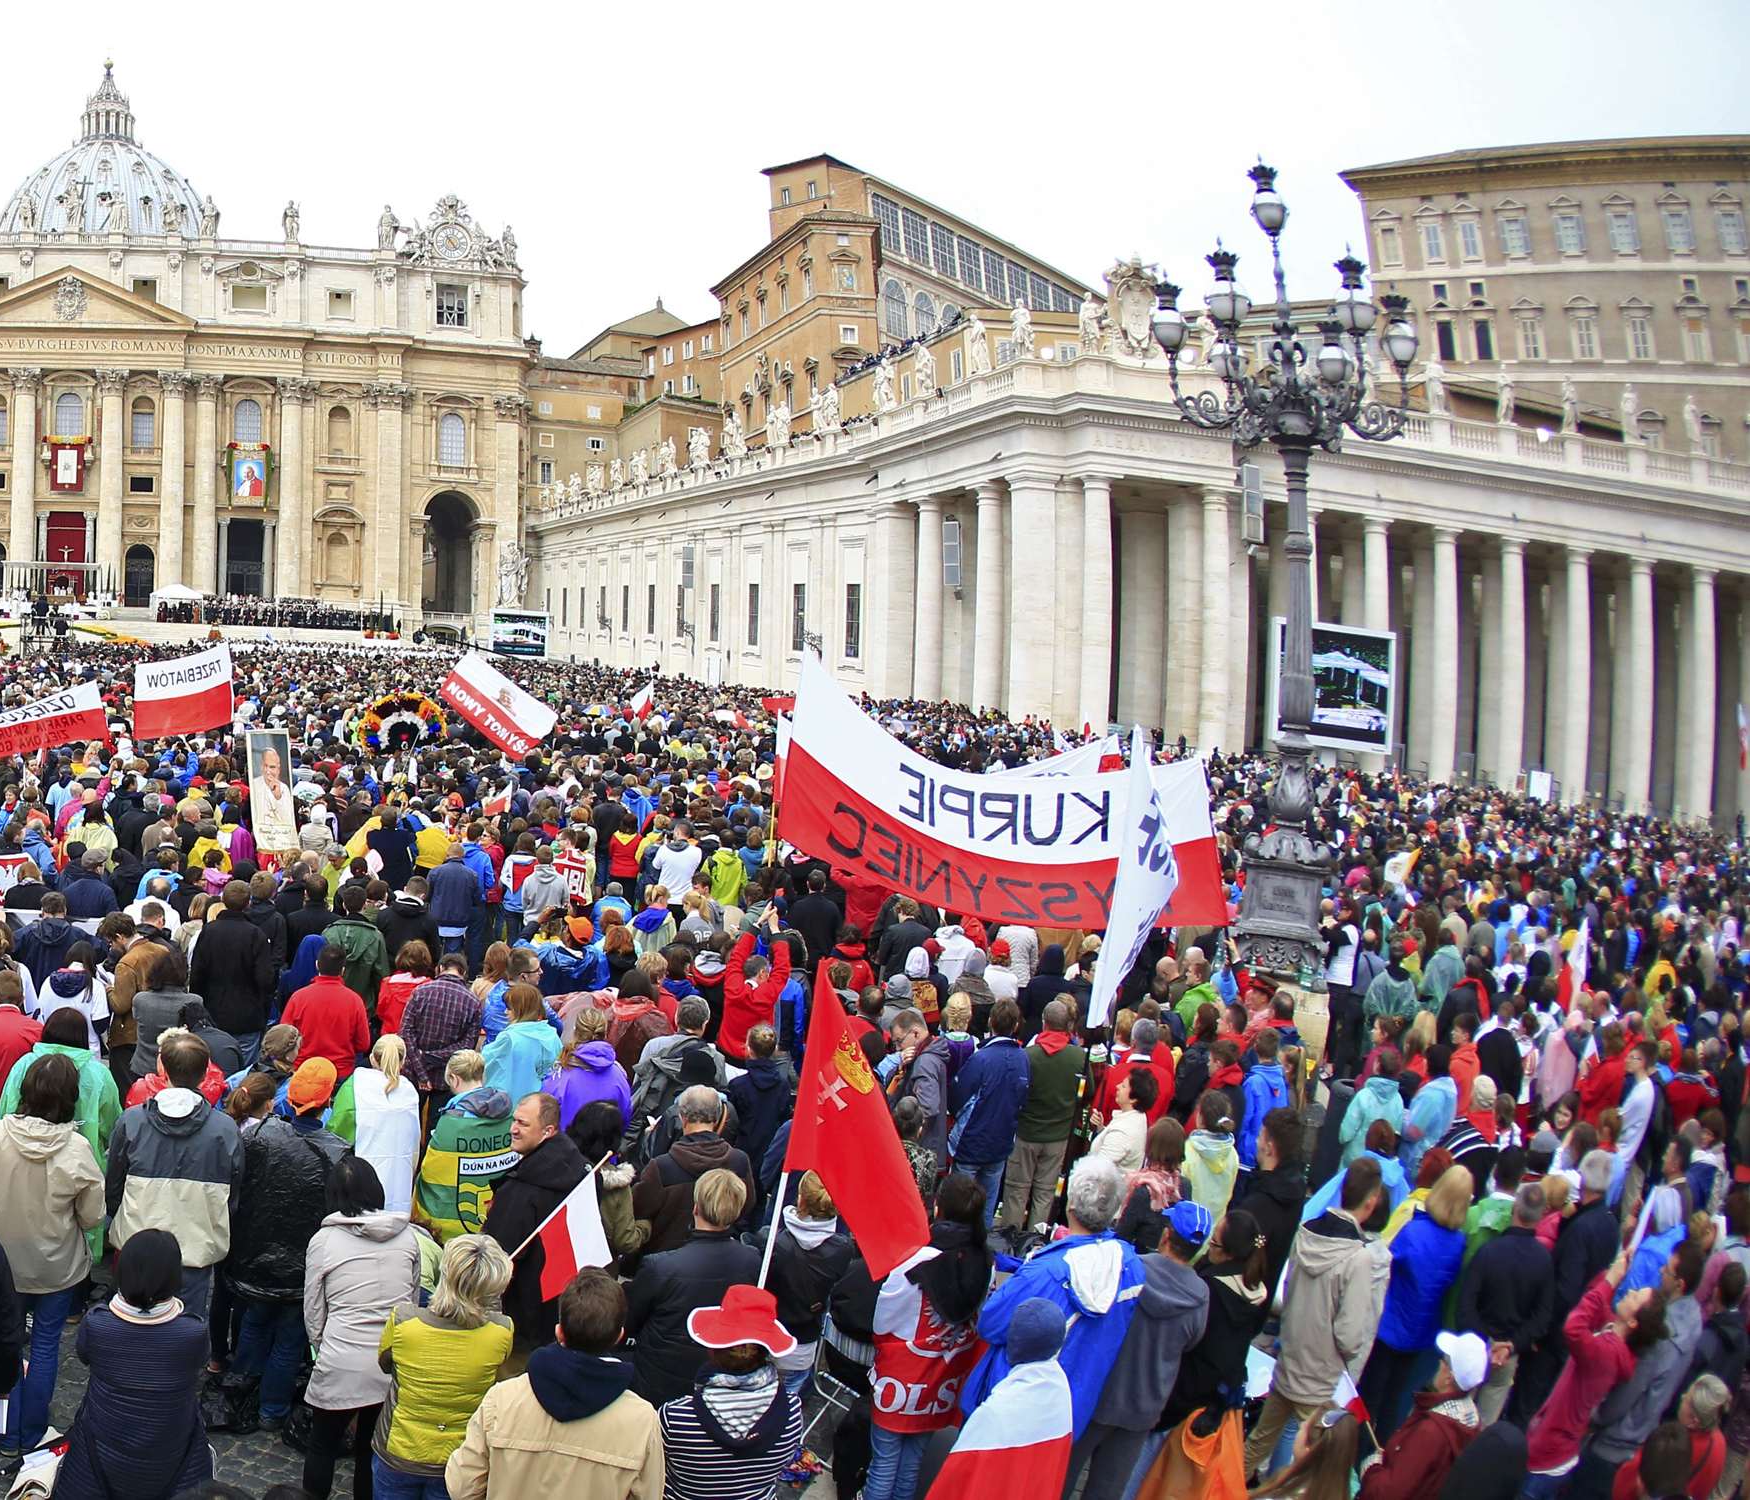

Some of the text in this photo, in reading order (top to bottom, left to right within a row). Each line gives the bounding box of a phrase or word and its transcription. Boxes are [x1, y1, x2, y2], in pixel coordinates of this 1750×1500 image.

[18, 339, 107, 351] BVRGHESIVS
[111, 340, 184, 352] ROMANVS
[381, 354, 401, 366] VII
[446, 681, 486, 717] NOWY
[462, 1161, 484, 1171] DÚN
[485, 1160, 498, 1169] NA
